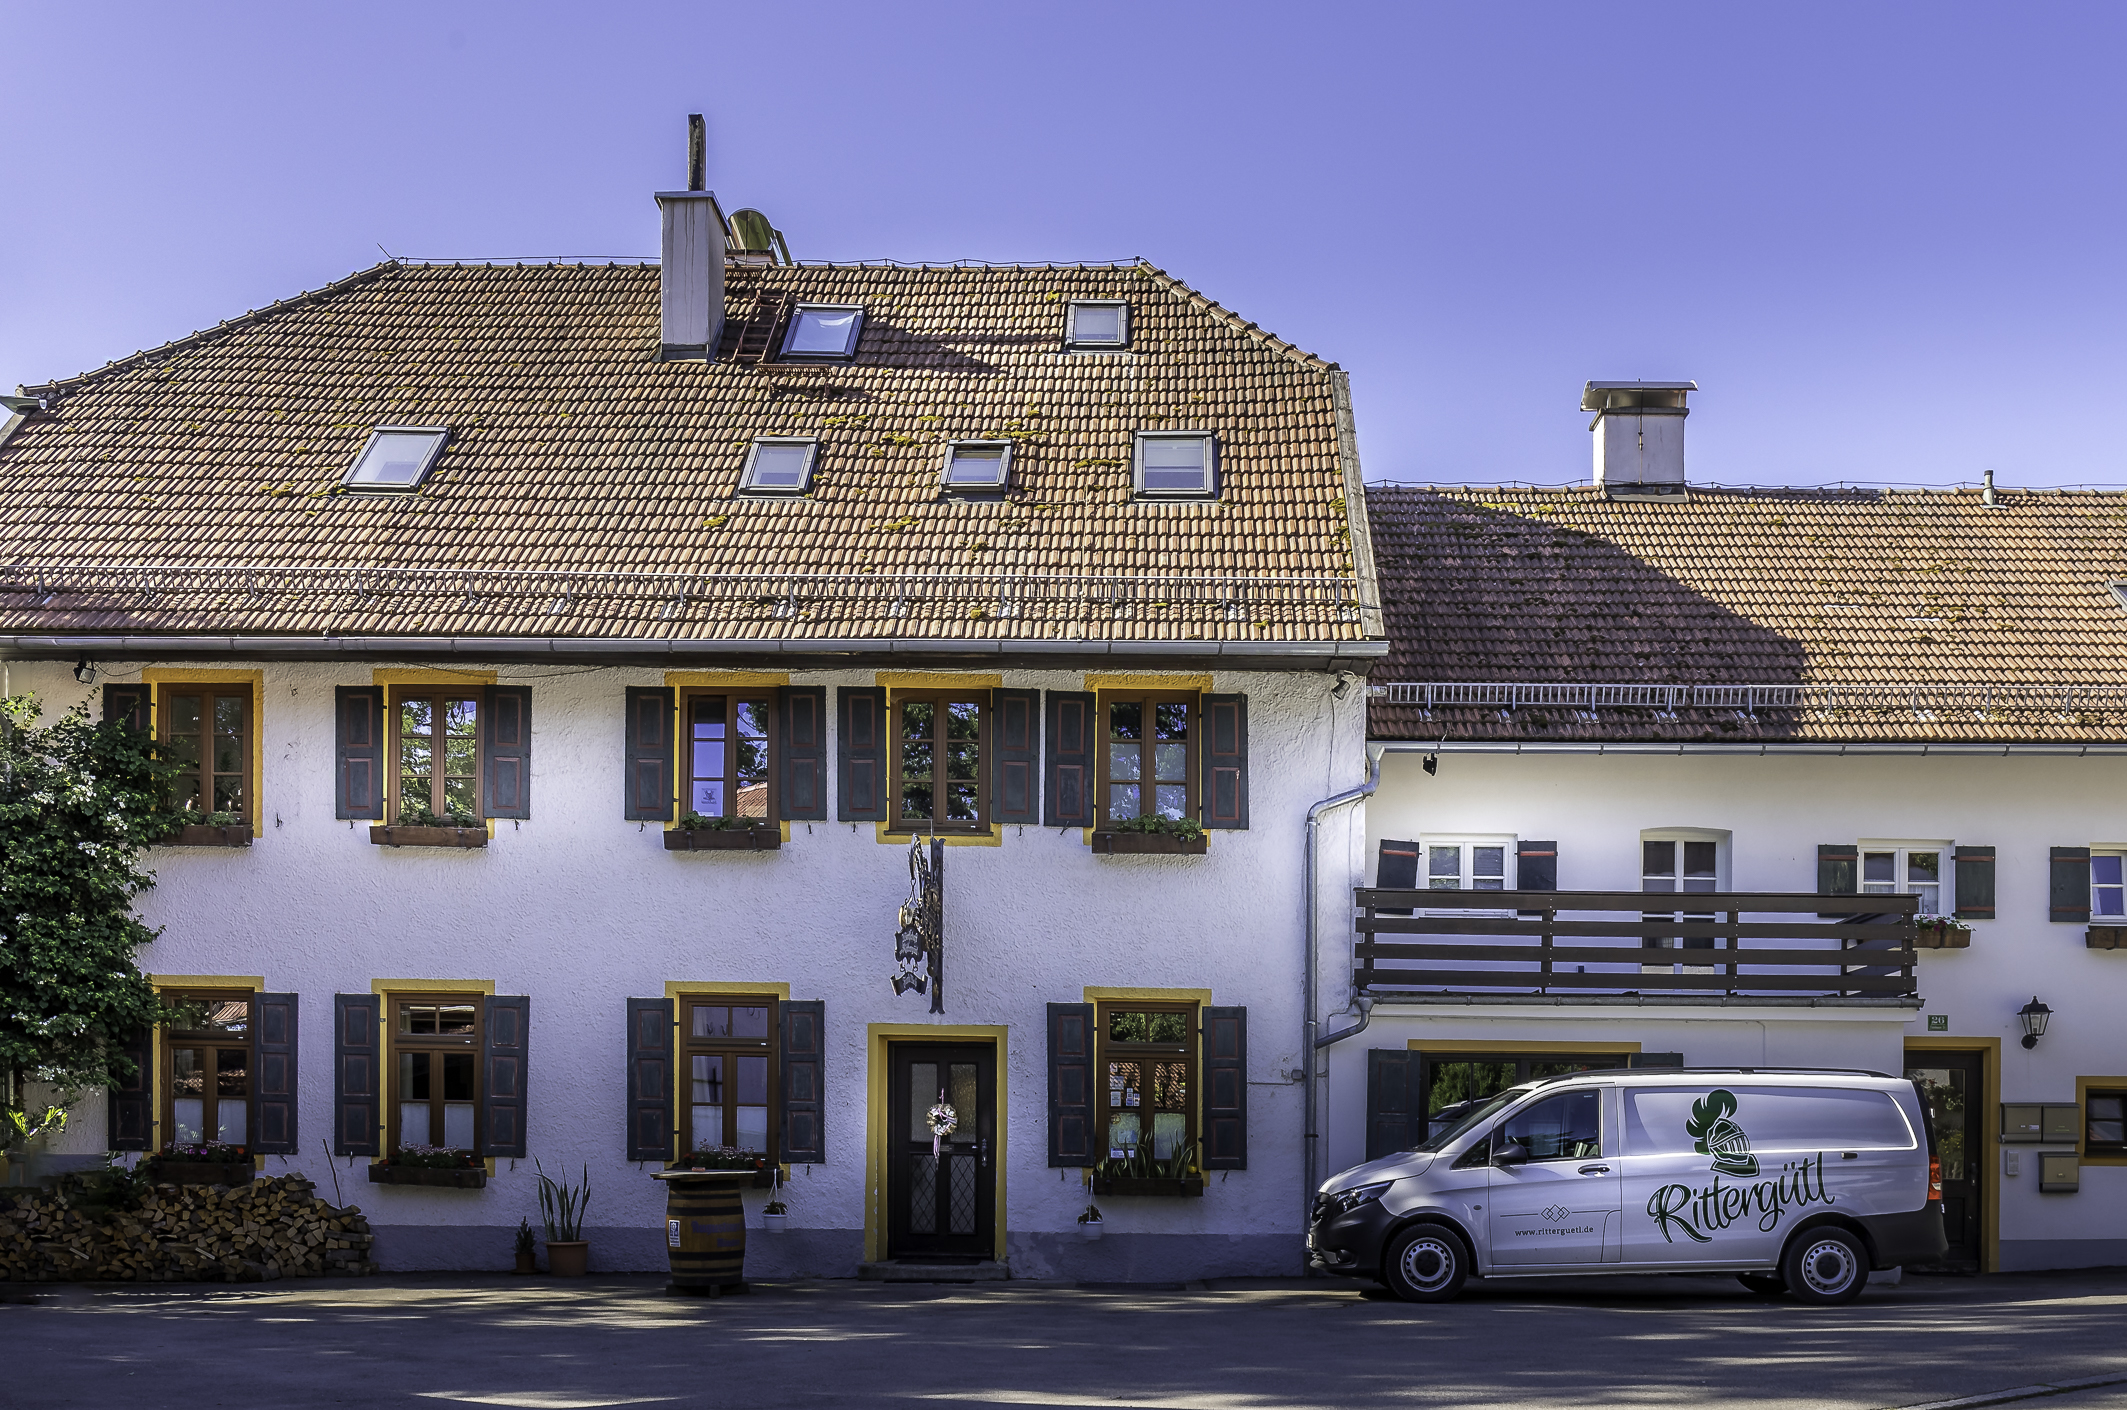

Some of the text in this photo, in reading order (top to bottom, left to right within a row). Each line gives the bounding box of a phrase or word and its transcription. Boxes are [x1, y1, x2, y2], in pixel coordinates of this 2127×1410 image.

[1931, 1016, 1945, 1024] 26
[1646, 1151, 1836, 1244] Rittergütl
[1514, 1225, 1594, 1237] www.ritterguetl.de
